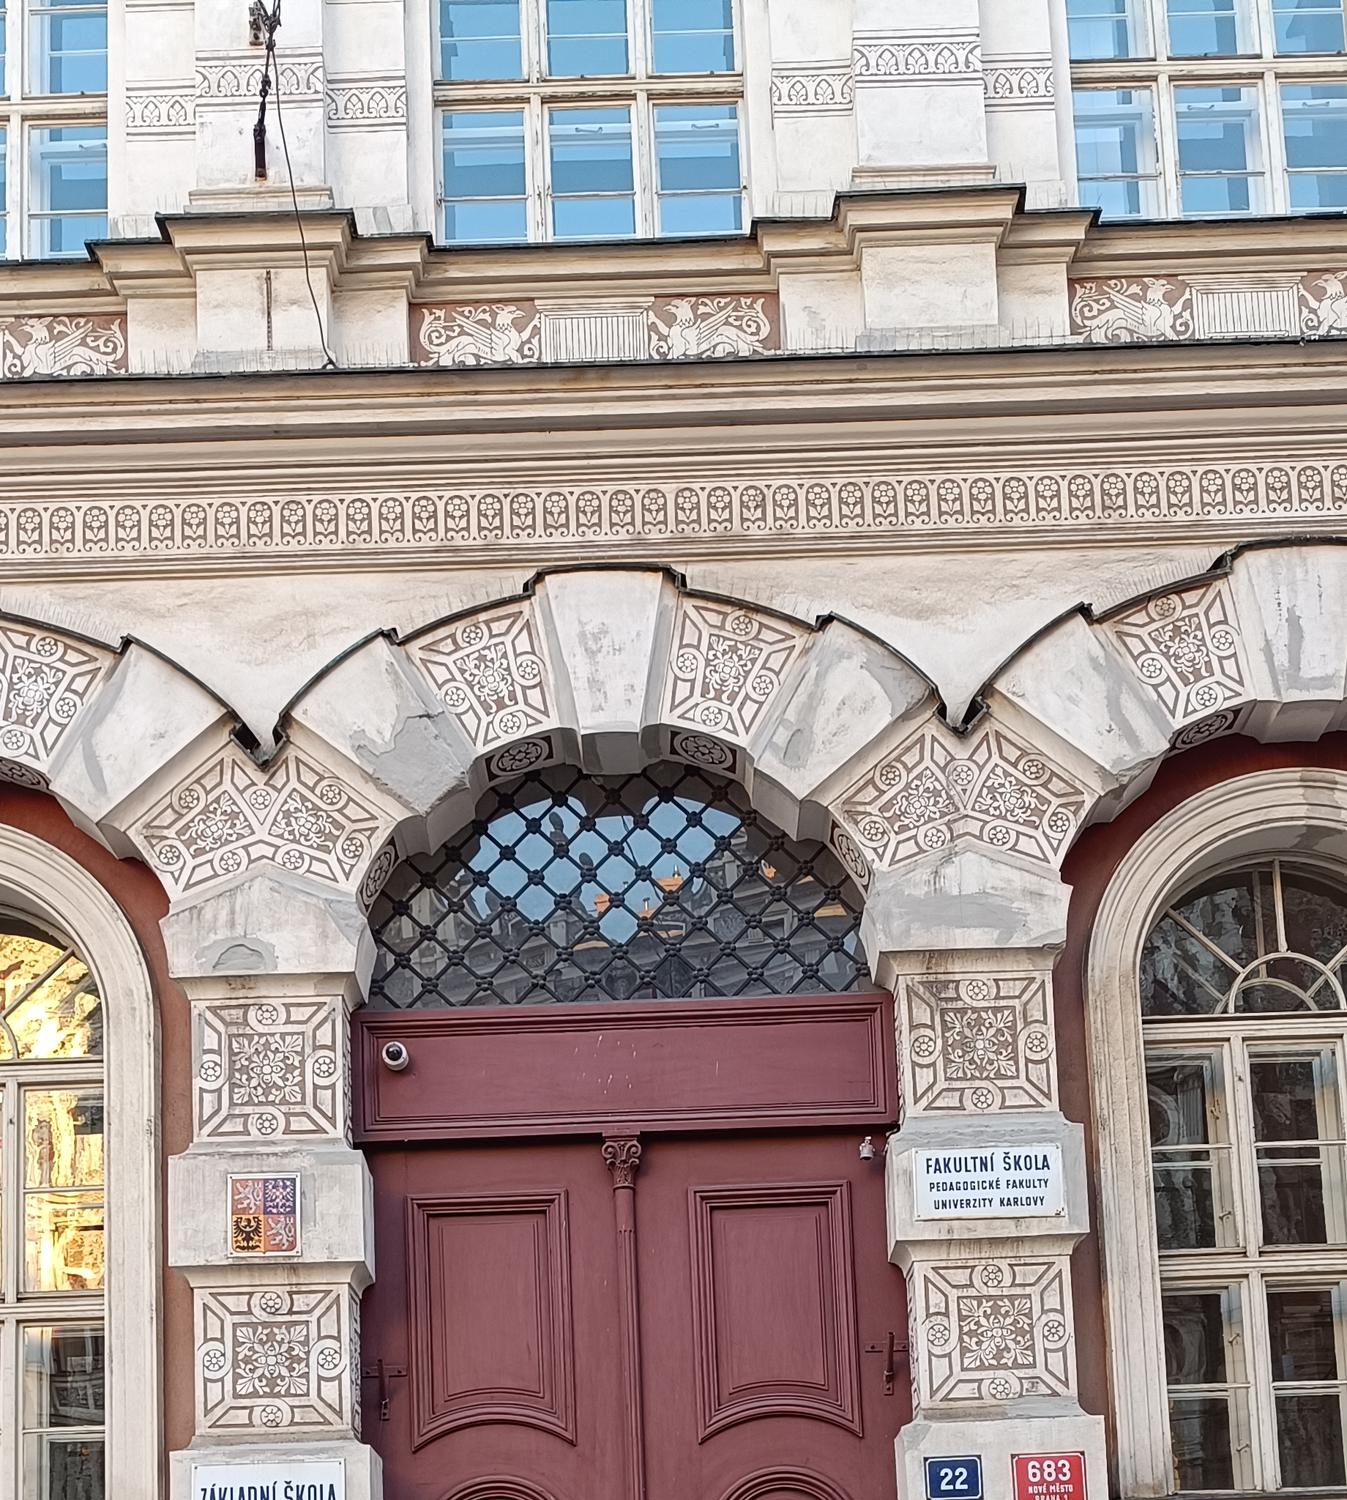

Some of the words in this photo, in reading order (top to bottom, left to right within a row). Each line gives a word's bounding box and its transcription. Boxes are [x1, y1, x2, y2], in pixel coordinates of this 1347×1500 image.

[926, 1152, 994, 1174] FAKULTNÍ
[1003, 1151, 1051, 1172] ŠKOLA
[929, 1177, 1001, 1192] PEDAGOGICKÉ
[1006, 1178, 1049, 1190] FAKULTY
[934, 1197, 994, 1210] UNIVERZITY
[999, 1196, 1045, 1207] KARLOVY
[939, 1467, 969, 1491] 22
[1027, 1459, 1071, 1483] 683
[1028, 1483, 1047, 1494] NOVÉ
[1049, 1482, 1073, 1493] MĚSTO
